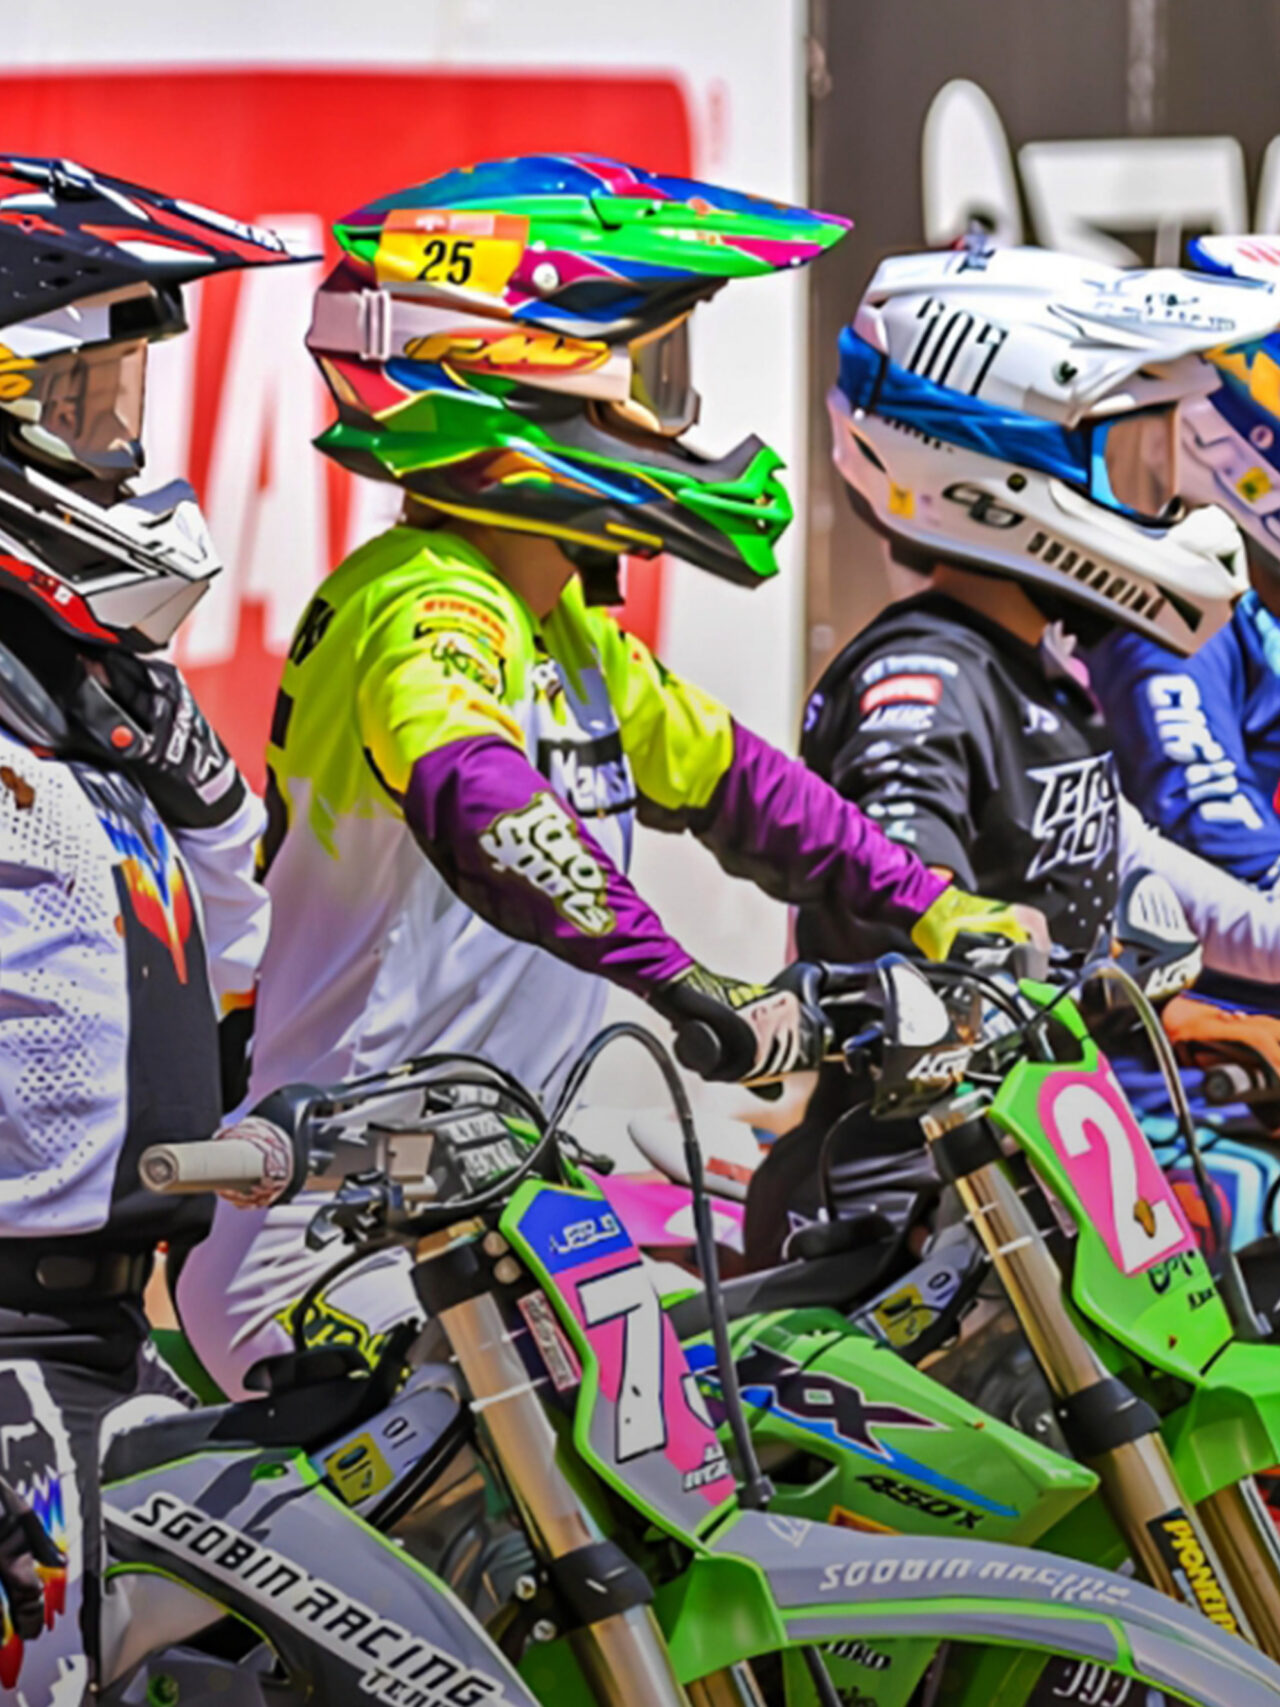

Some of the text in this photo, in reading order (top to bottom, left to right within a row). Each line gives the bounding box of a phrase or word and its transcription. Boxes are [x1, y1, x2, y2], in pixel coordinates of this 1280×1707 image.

[417, 240, 474, 285] 25
[1052, 1083, 1186, 1277] 2
[575, 1260, 668, 1465] 7
[132, 1497, 496, 1707] SGOBIN RACING
